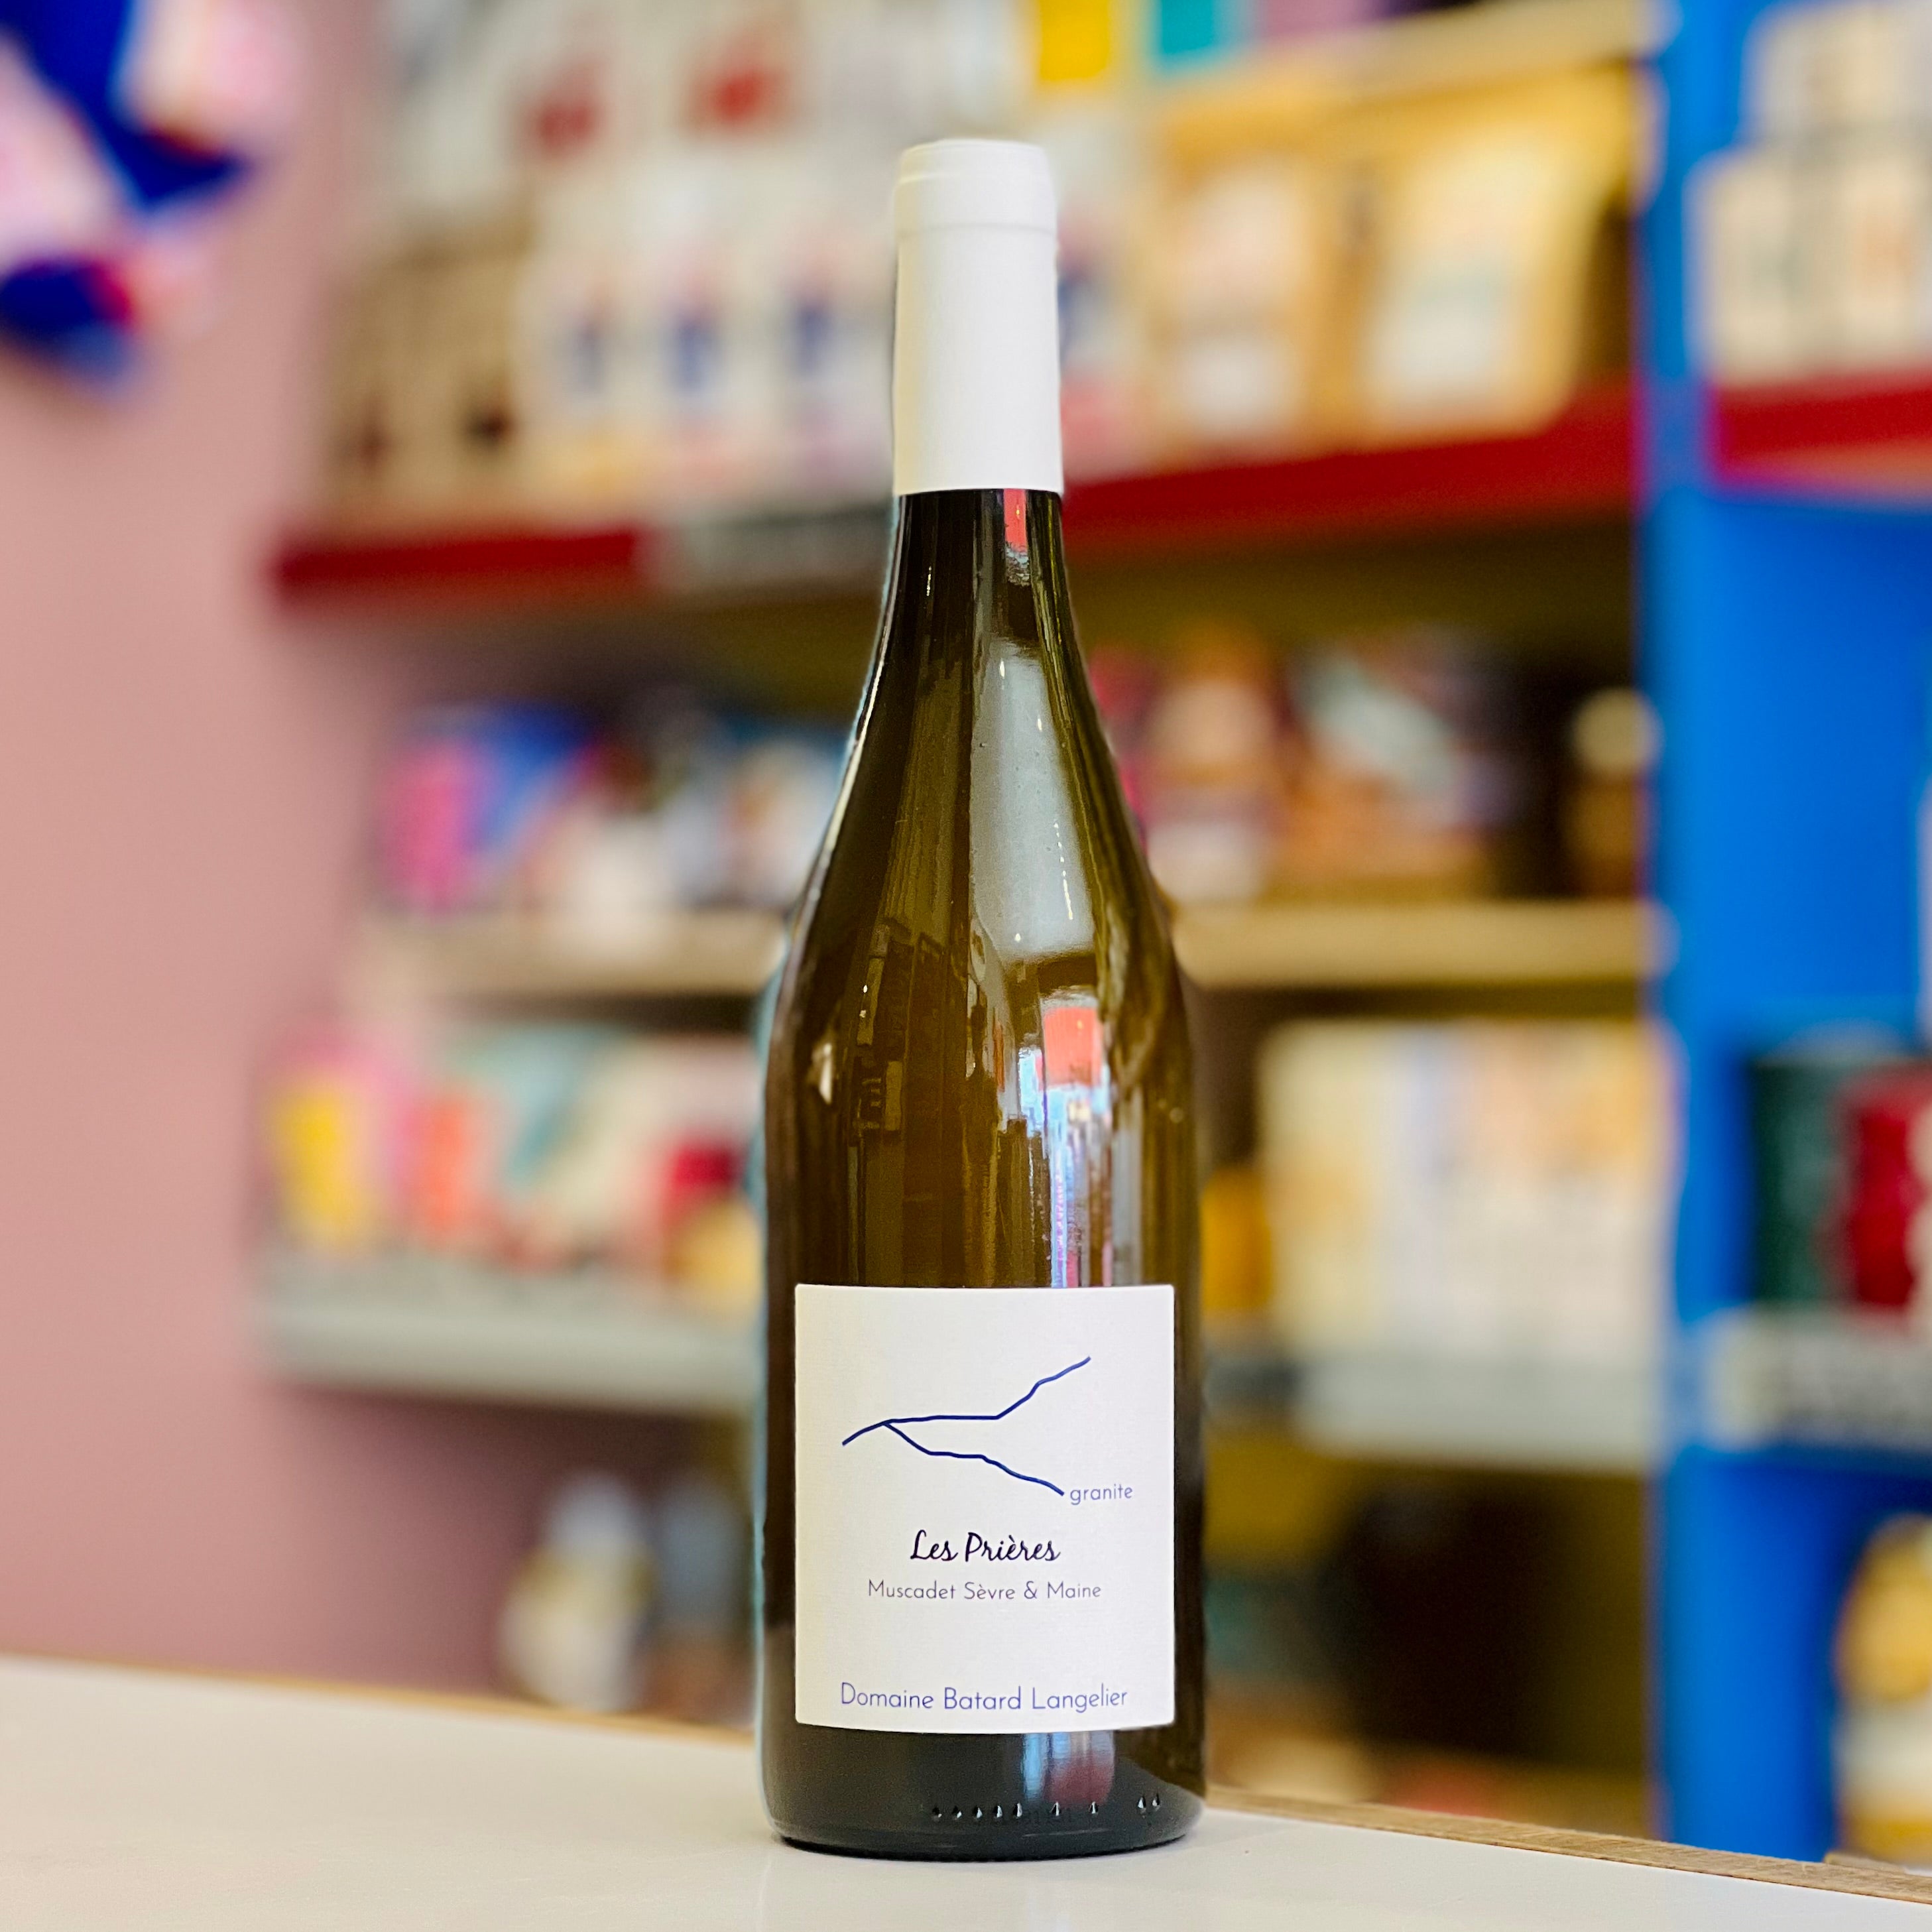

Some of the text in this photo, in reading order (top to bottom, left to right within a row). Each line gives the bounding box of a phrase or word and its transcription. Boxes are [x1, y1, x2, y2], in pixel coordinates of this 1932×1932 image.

[1070, 1483, 1132, 1505] granite
[910, 1530, 1061, 1563] Les Prières
[869, 1579, 1101, 1599] Muscadet Sèvre & Maine
[841, 1682, 1127, 1713] Domaine Batard Langelier
